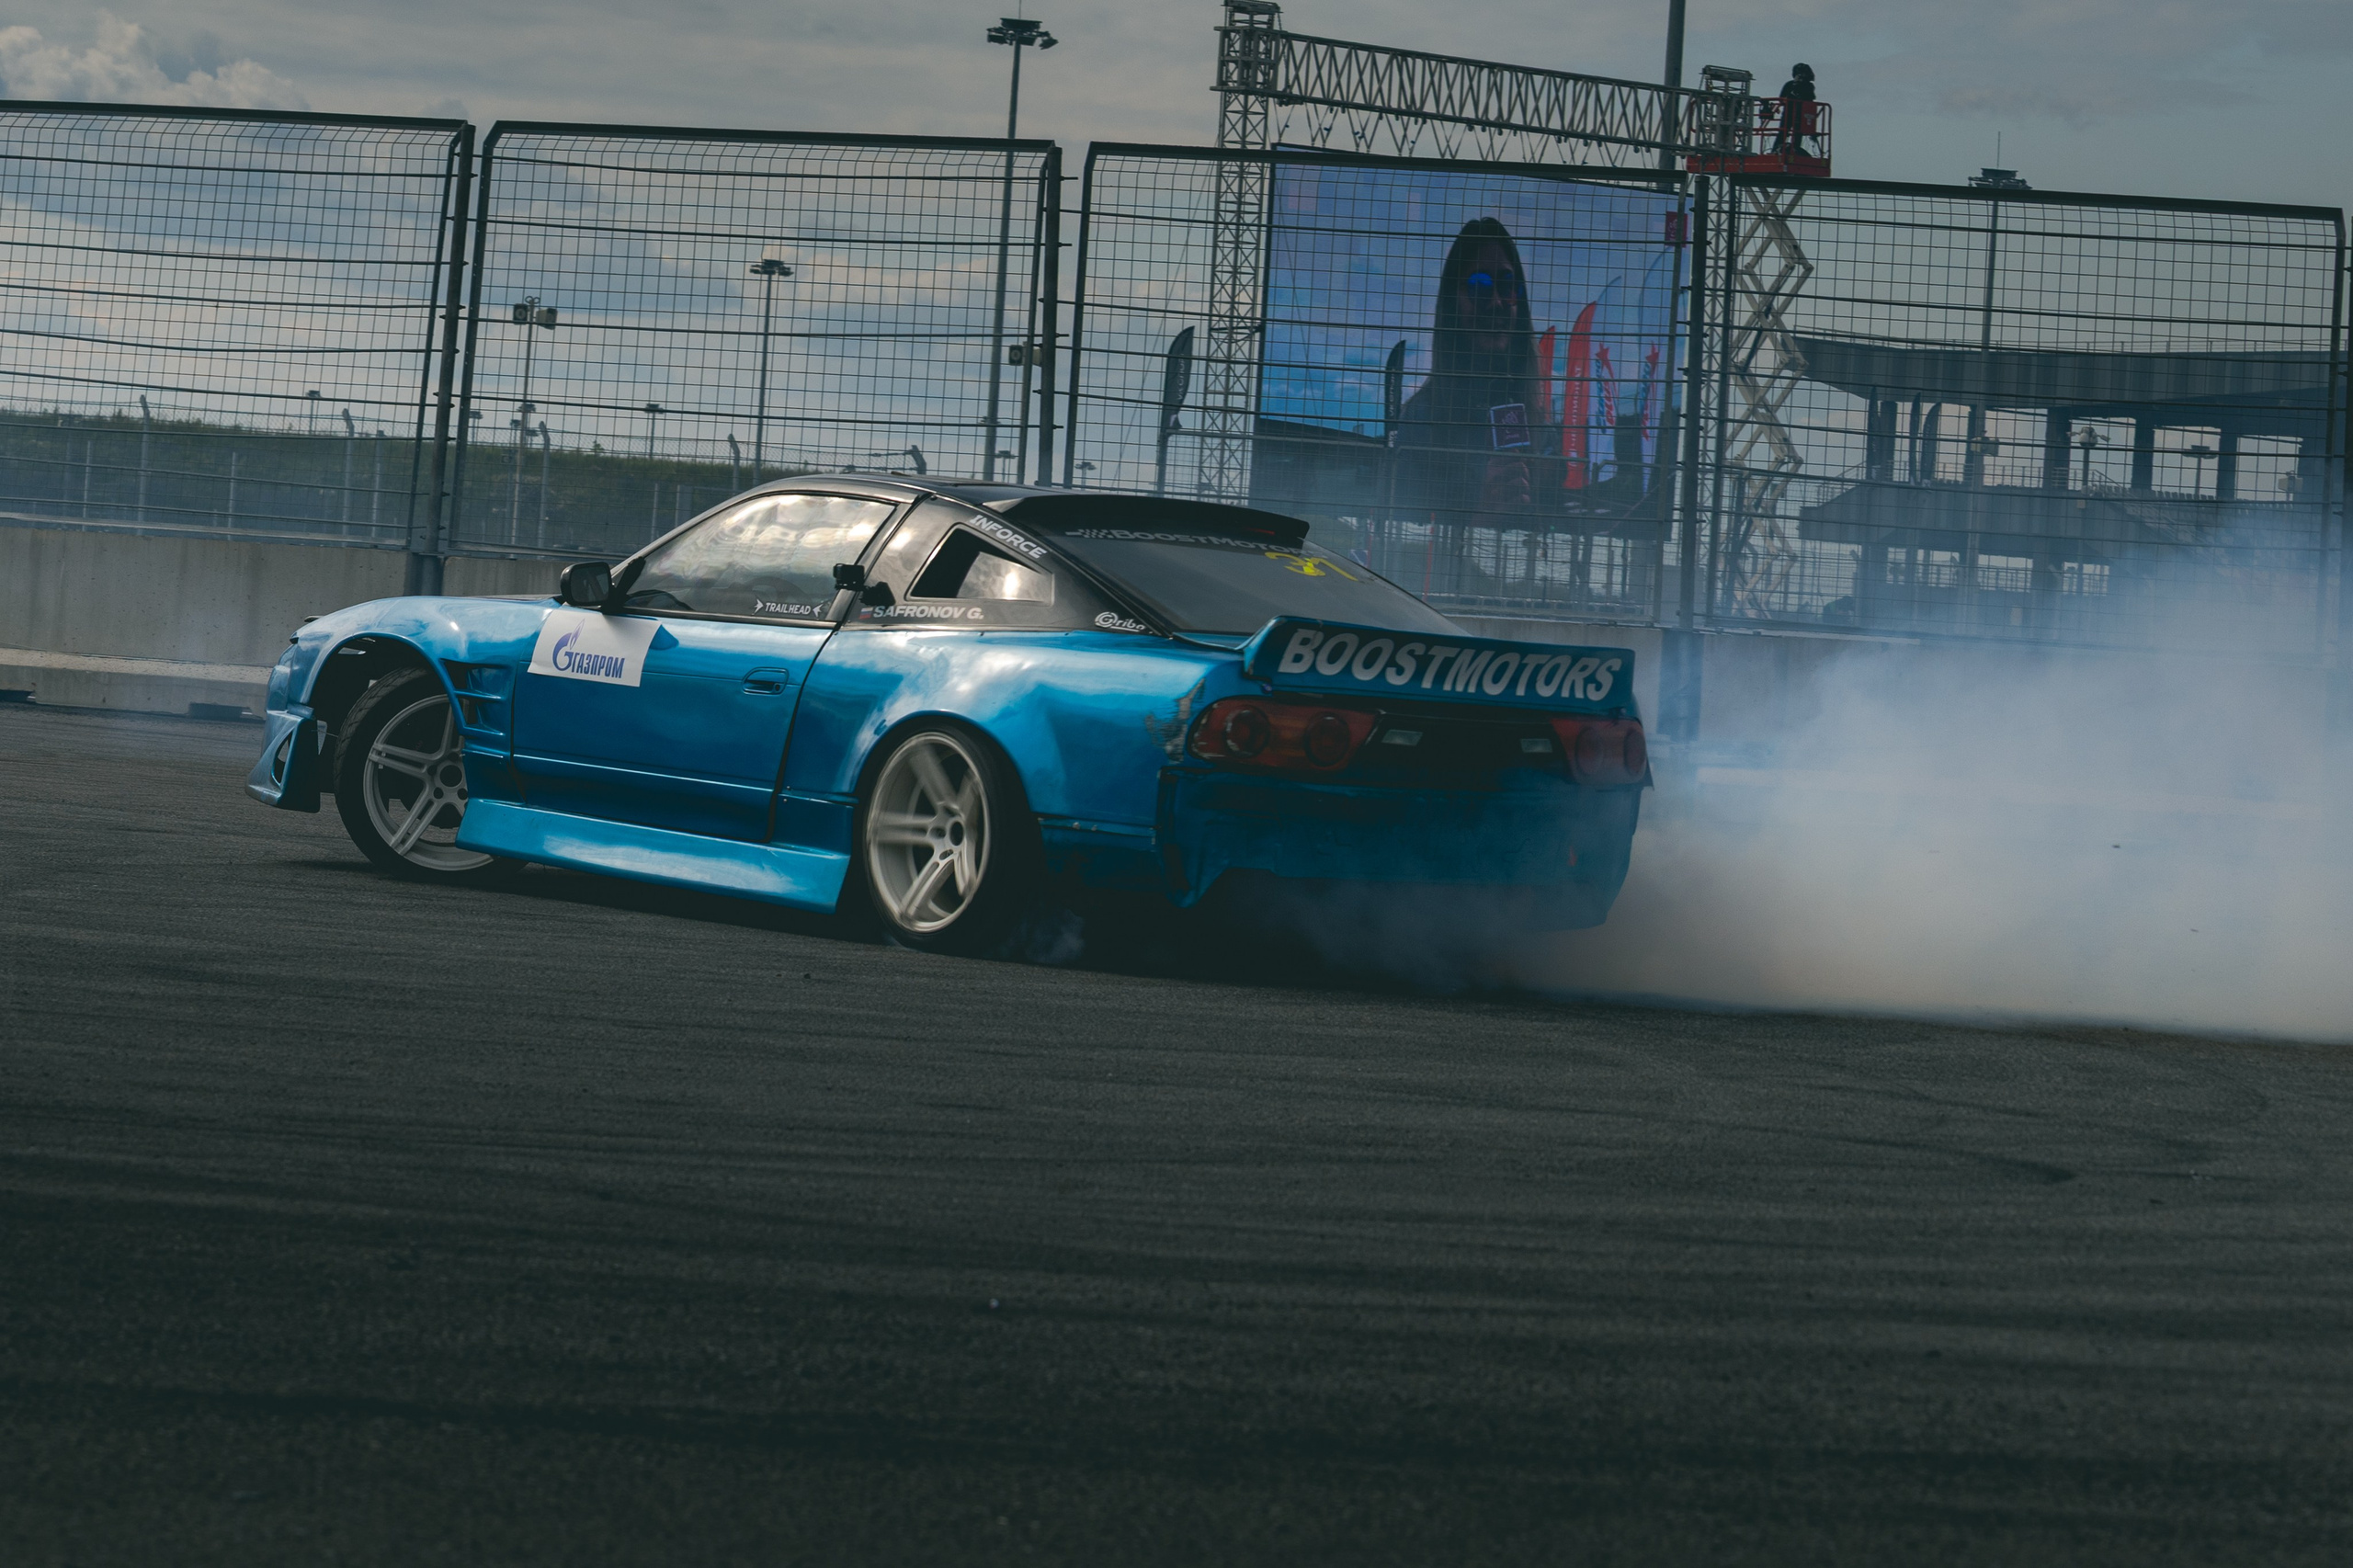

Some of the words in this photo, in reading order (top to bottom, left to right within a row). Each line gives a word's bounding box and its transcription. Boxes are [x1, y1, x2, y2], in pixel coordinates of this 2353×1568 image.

[969, 515, 1047, 559] INFORCE
[765, 601, 812, 615] TRAILHEAD
[873, 606, 966, 619] SAFRONOV
[967, 607, 984, 619] G.
[572, 652, 625, 678] ГАЗПРОМ
[1278, 629, 1621, 701] BOOSTMOTORS
